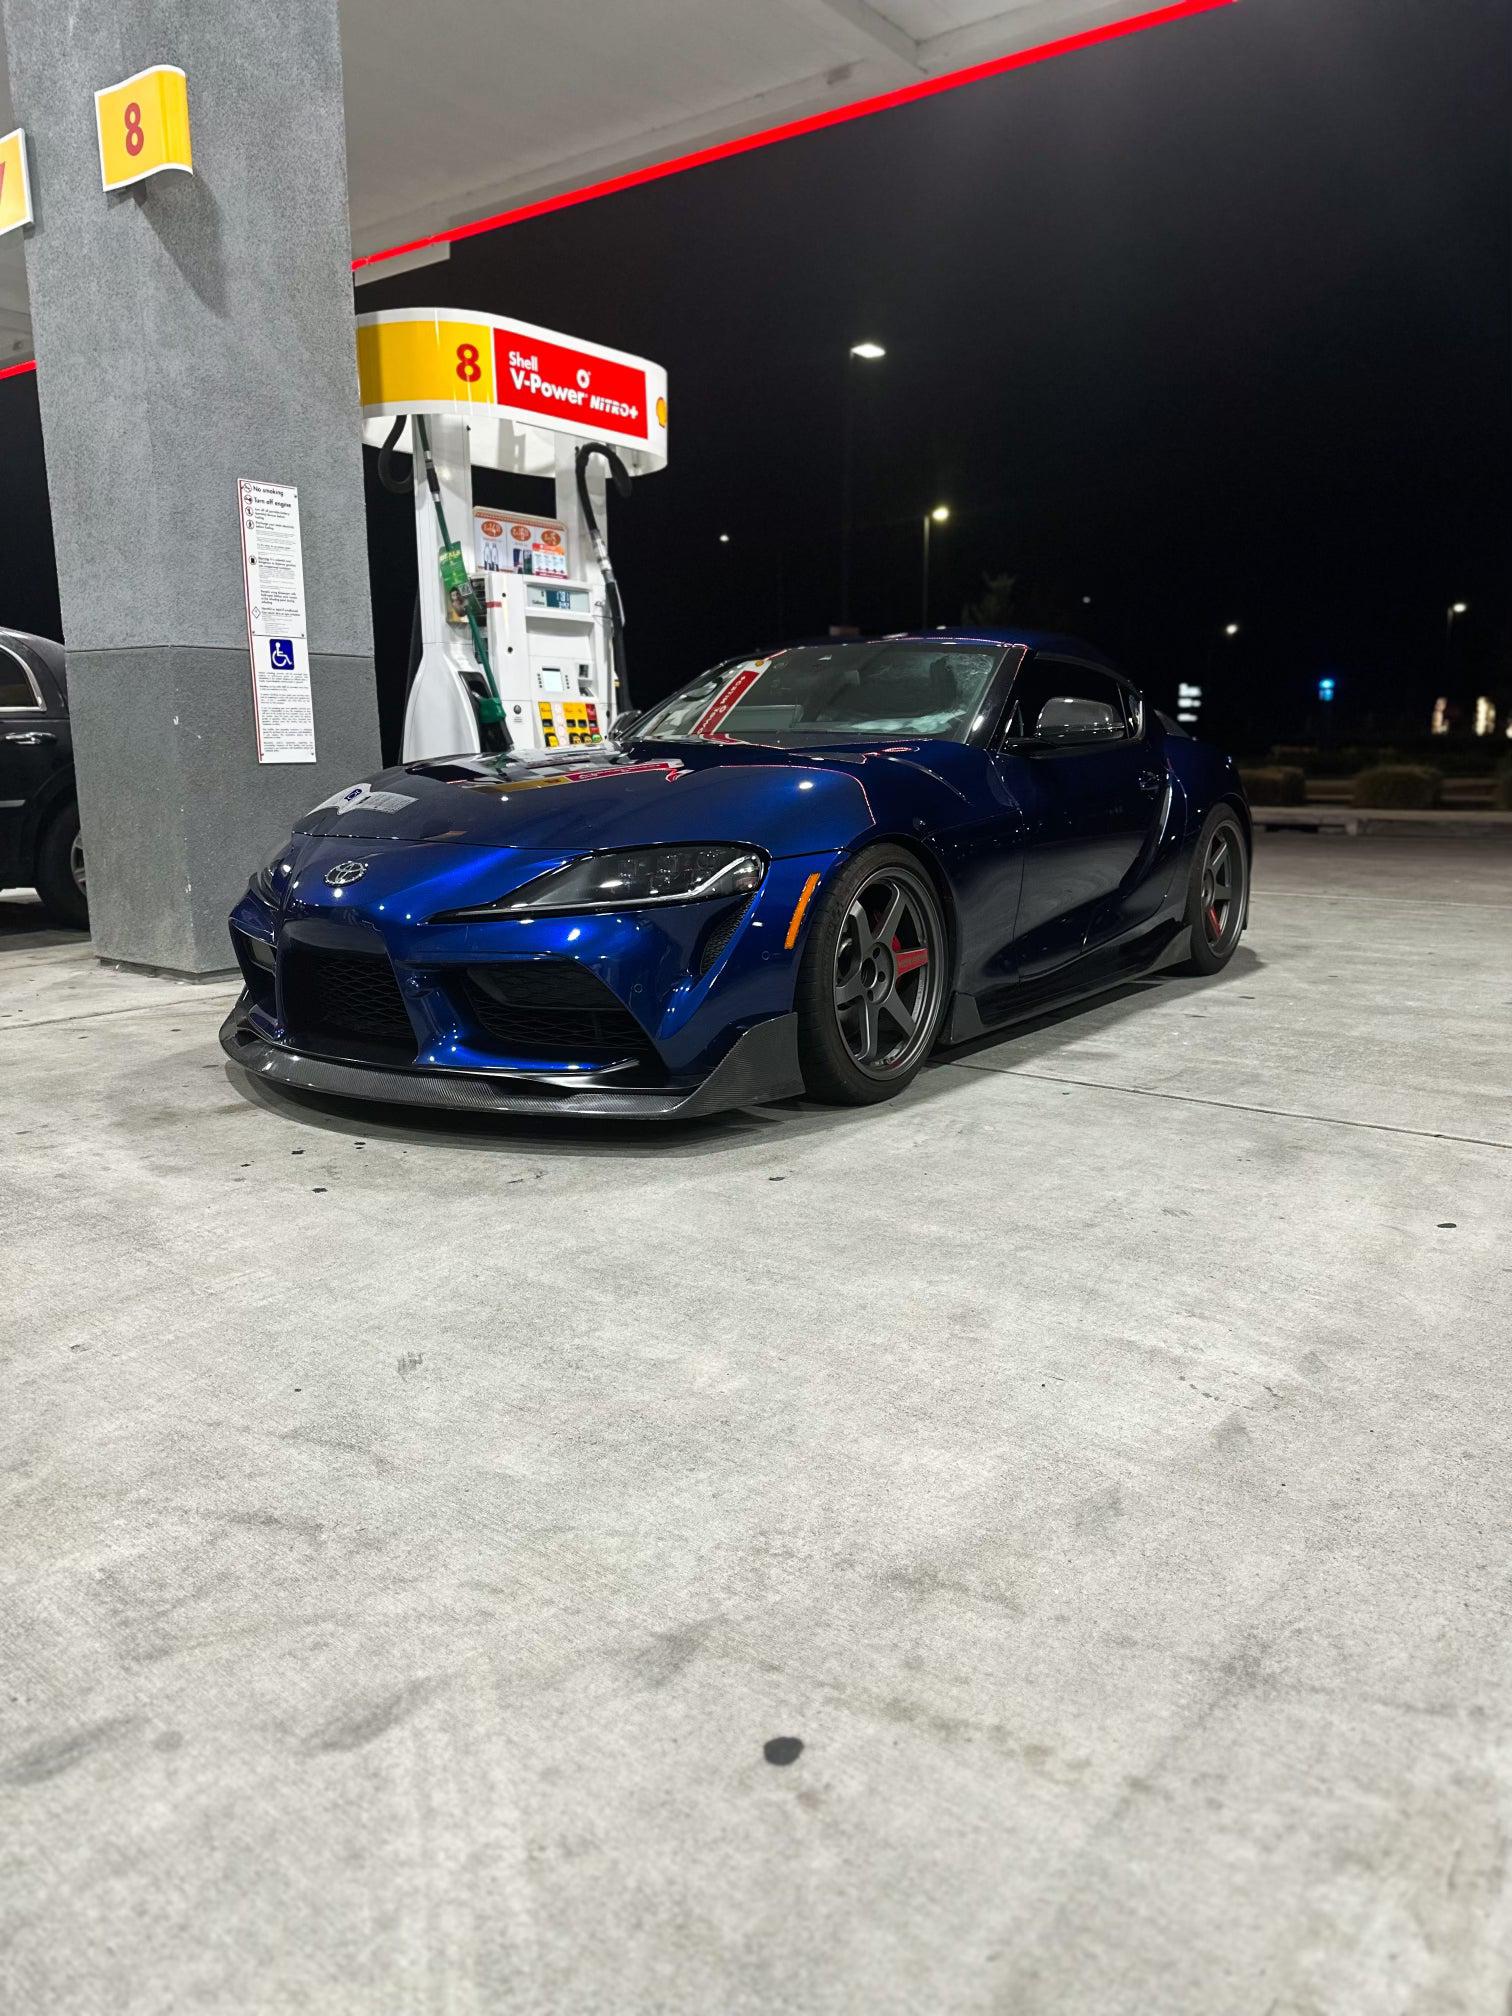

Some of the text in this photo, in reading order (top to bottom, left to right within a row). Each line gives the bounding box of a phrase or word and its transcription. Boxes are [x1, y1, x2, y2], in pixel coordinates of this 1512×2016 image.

[124, 102, 144, 157] 8
[456, 344, 482, 382] 8
[508, 351, 539, 372] Shell
[509, 367, 583, 406] V-Power
[254, 496, 265, 504] Turn
[263, 488, 284, 497] smoking
